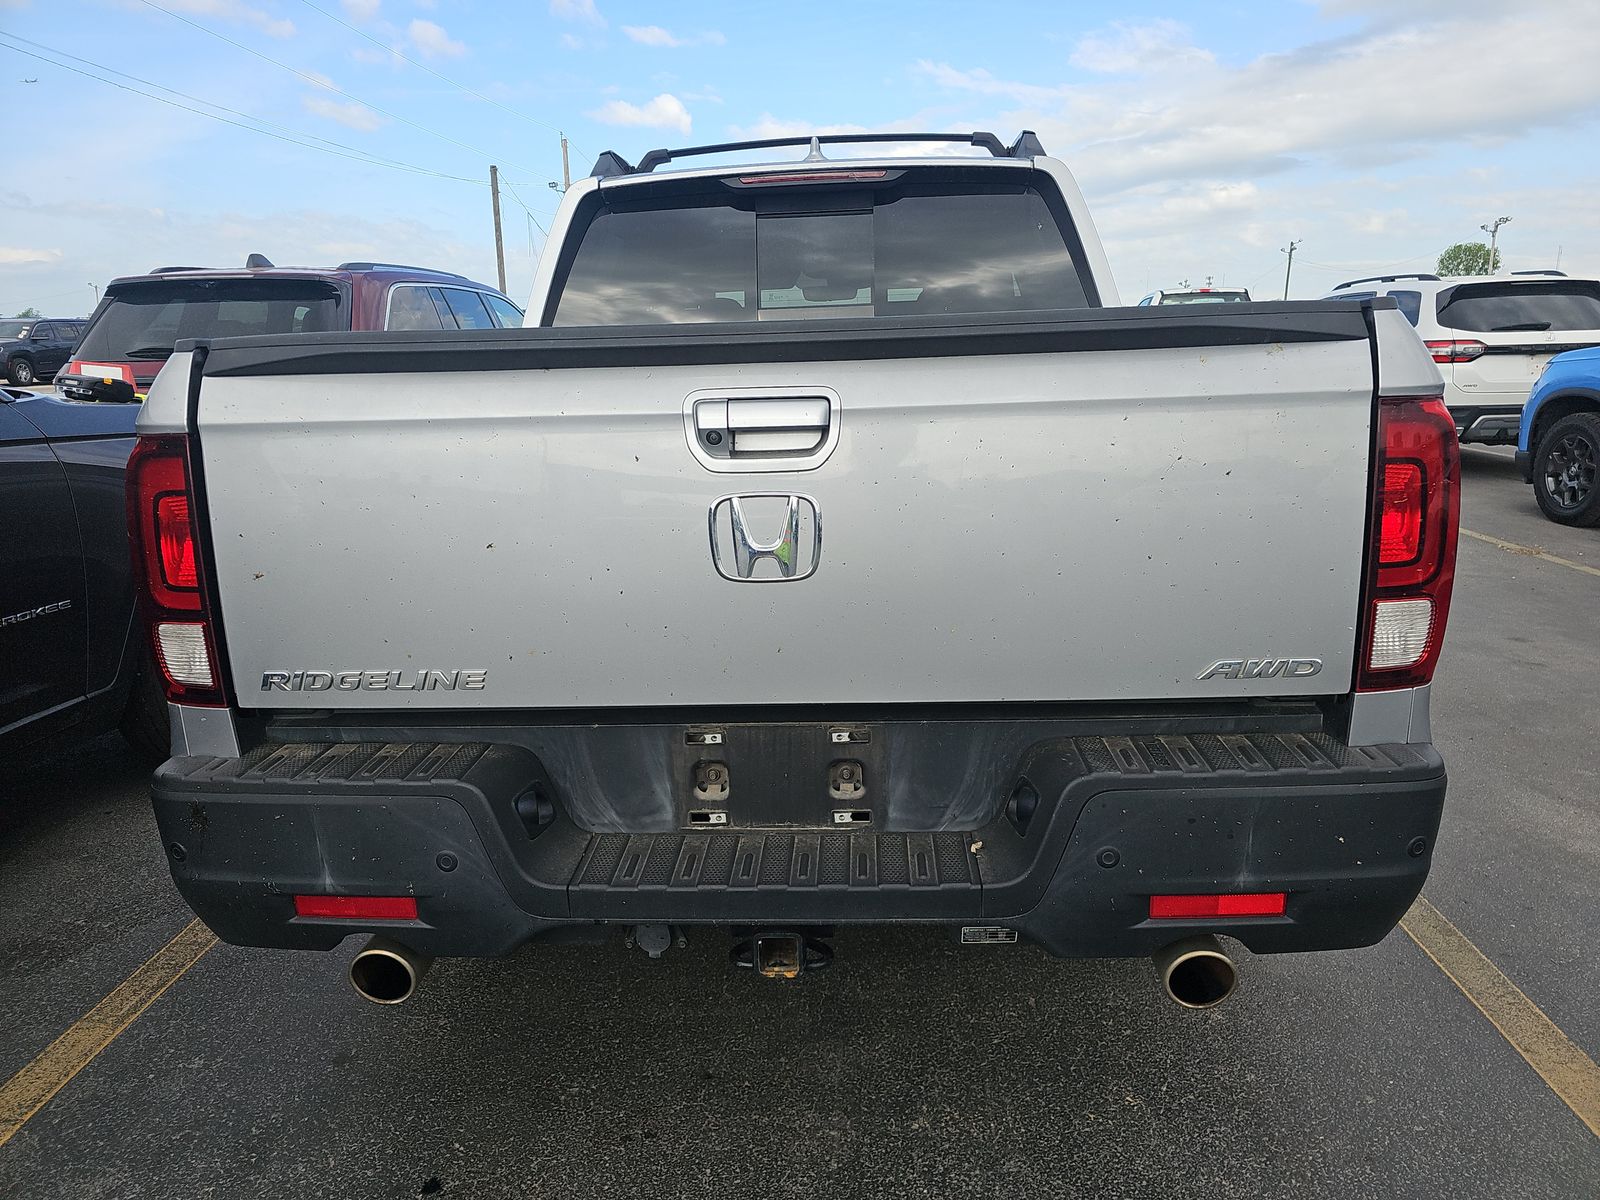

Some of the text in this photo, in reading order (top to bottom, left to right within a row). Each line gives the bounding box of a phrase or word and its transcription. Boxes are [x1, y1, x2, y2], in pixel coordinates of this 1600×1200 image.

[0, 599, 72, 627] ROKEE
[1196, 659, 1322, 680] AWD
[261, 670, 488, 691] RIDGELINE
